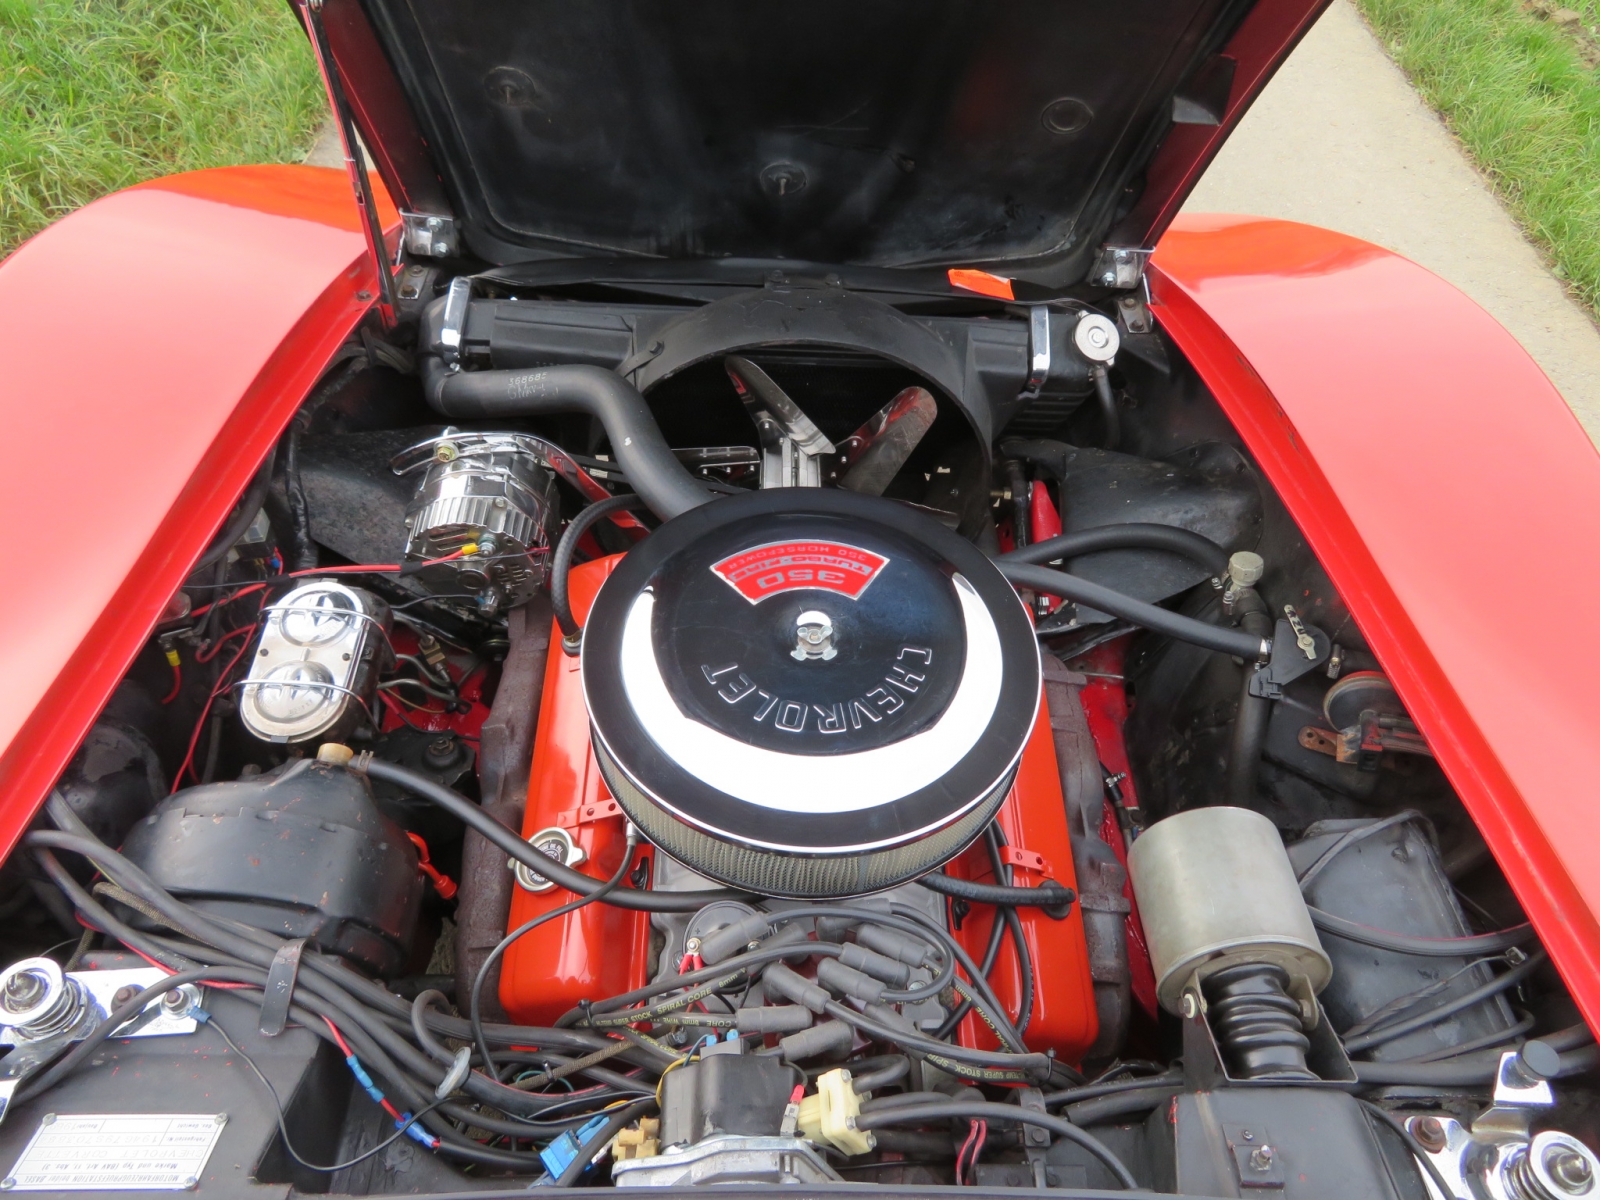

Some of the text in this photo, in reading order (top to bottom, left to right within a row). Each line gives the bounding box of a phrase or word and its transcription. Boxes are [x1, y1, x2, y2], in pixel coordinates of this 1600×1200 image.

[728, 544, 867, 570] 350 HORSEPOWER
[756, 569, 846, 590] 350
[700, 643, 933, 734] CHEVROLET
[630, 1010, 653, 1022] STOCK
[657, 1000, 686, 1015] SPIRAL
[687, 986, 713, 1003] CORE
[718, 973, 739, 988] 8mm
[706, 1020, 732, 1028] CORE
[954, 1064, 981, 1077] STOCK
[983, 1071, 1004, 1080] SUPER
[37, 1149, 204, 1159] CHEVROLET CORVETTE
[122, 1161, 135, 1170] Typ
[136, 1162, 152, 1170] und
[154, 1162, 179, 1170] Marke
[24, 1175, 48, 1184] BASEL
[48, 1174, 71, 1182] beider
